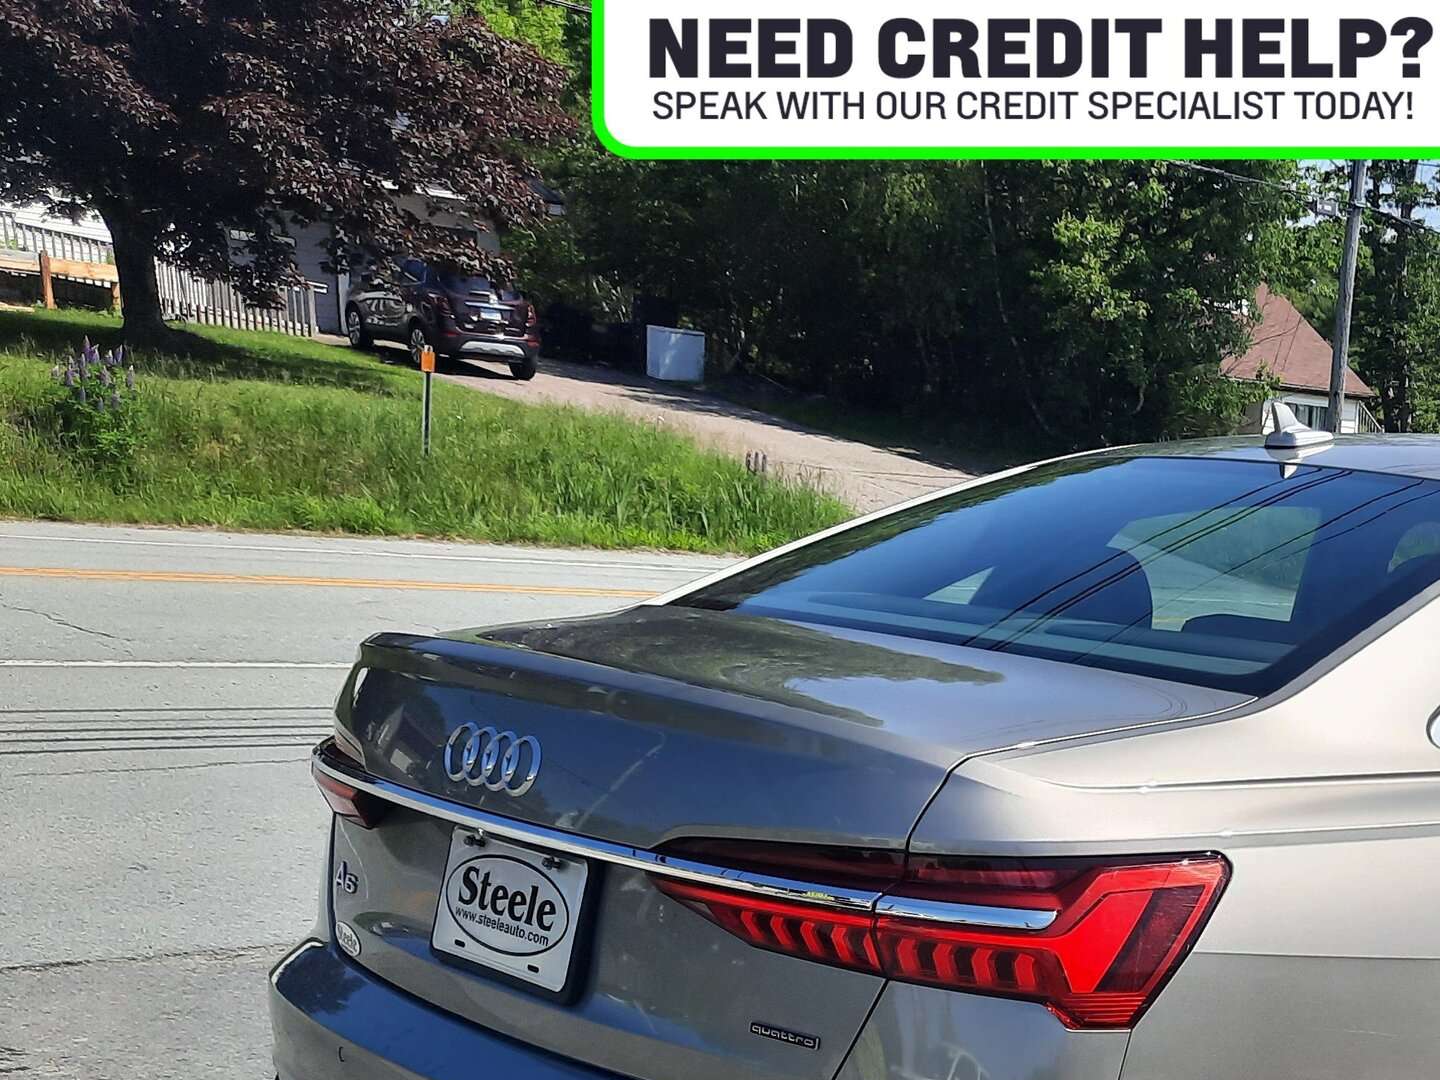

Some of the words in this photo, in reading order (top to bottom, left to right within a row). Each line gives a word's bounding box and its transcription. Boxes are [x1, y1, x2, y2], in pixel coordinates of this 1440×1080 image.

[336, 861, 358, 894] A6
[458, 866, 556, 932] Steele
[455, 906, 549, 946] www.steeleauto.com
[751, 1024, 815, 1048] quattro
